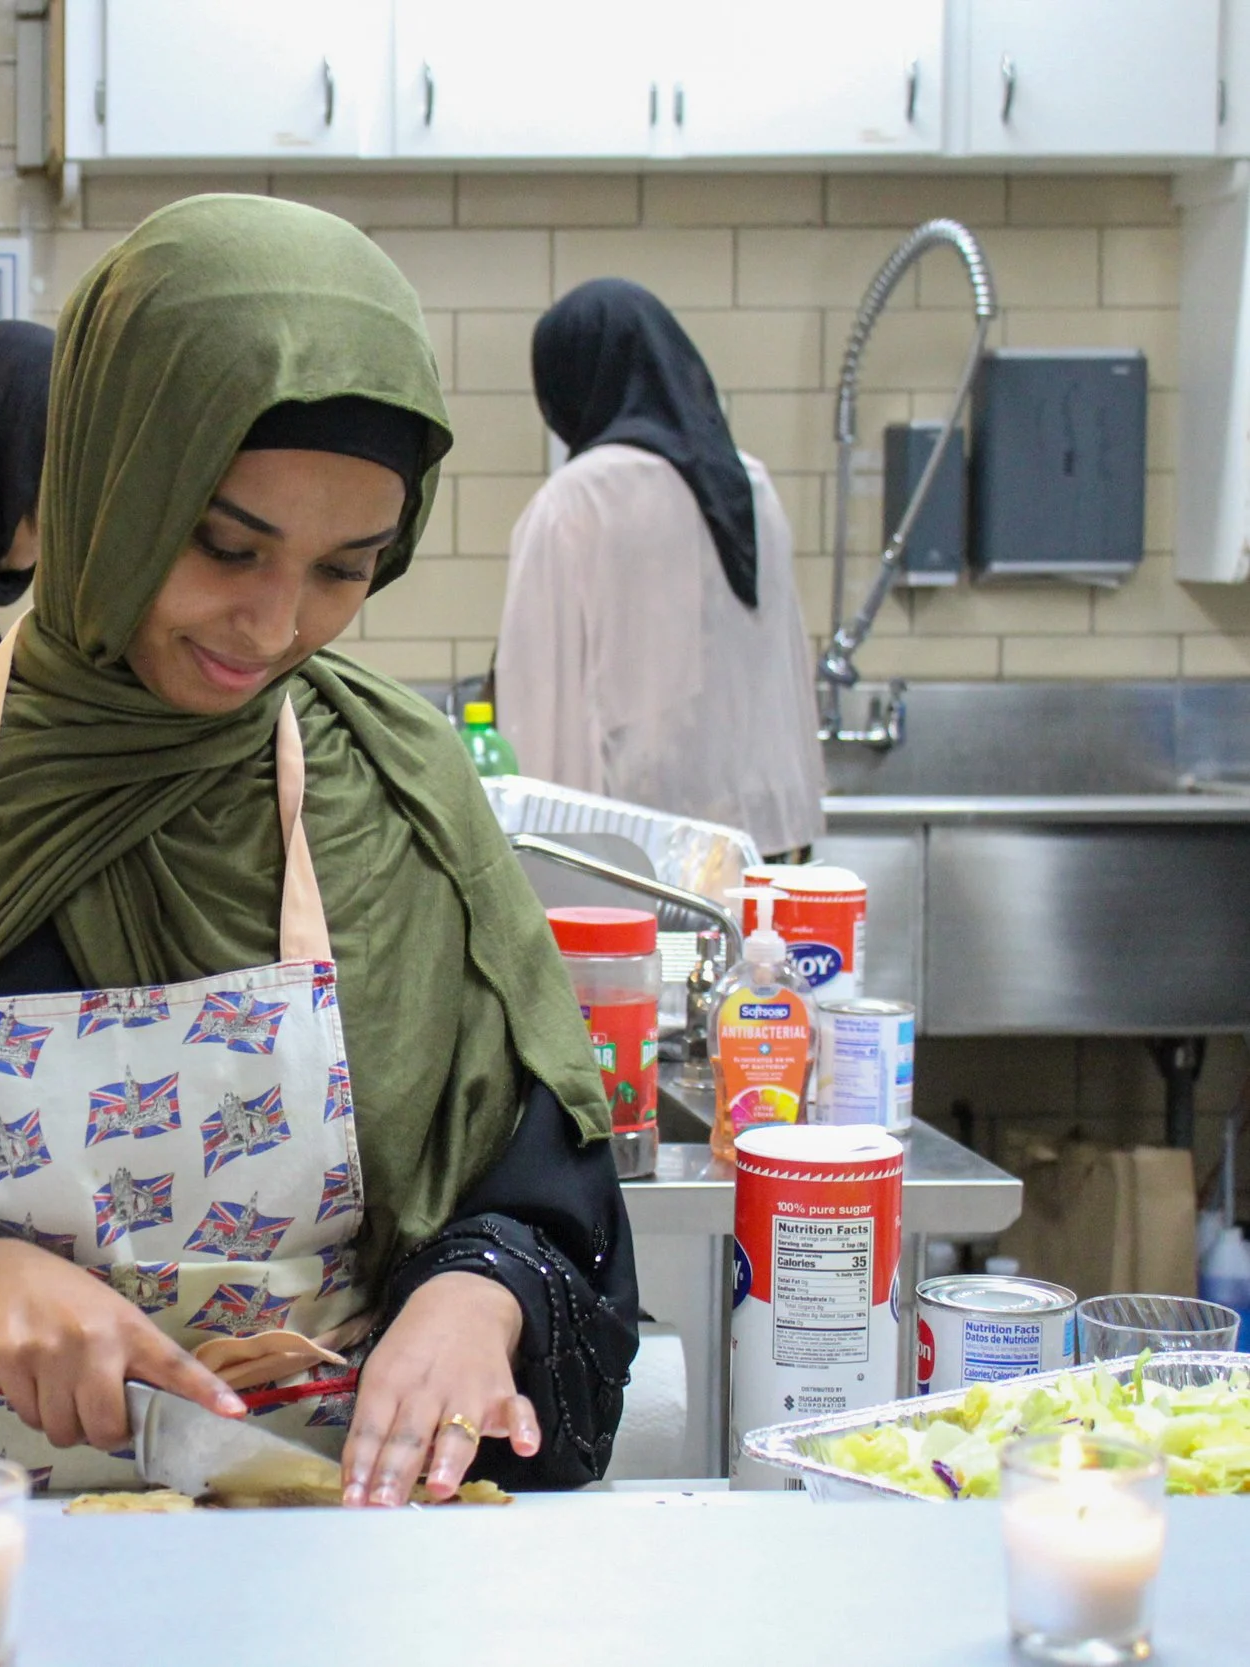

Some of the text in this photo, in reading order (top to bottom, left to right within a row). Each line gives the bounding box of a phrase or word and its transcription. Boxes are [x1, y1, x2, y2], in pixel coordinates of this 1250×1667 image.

[741, 1005, 788, 1019] Softsoap
[721, 1026, 807, 1039] ANTIBACTERIAL
[777, 1202, 871, 1216] 100% pure sugar
[778, 1222, 868, 1234] Nutrition Facts
[777, 1257, 816, 1268] Calories
[852, 1256, 867, 1267] 35
[965, 1322, 1040, 1334] Nutrition Facts
[965, 1332, 1040, 1345] Datos de Nutrición
